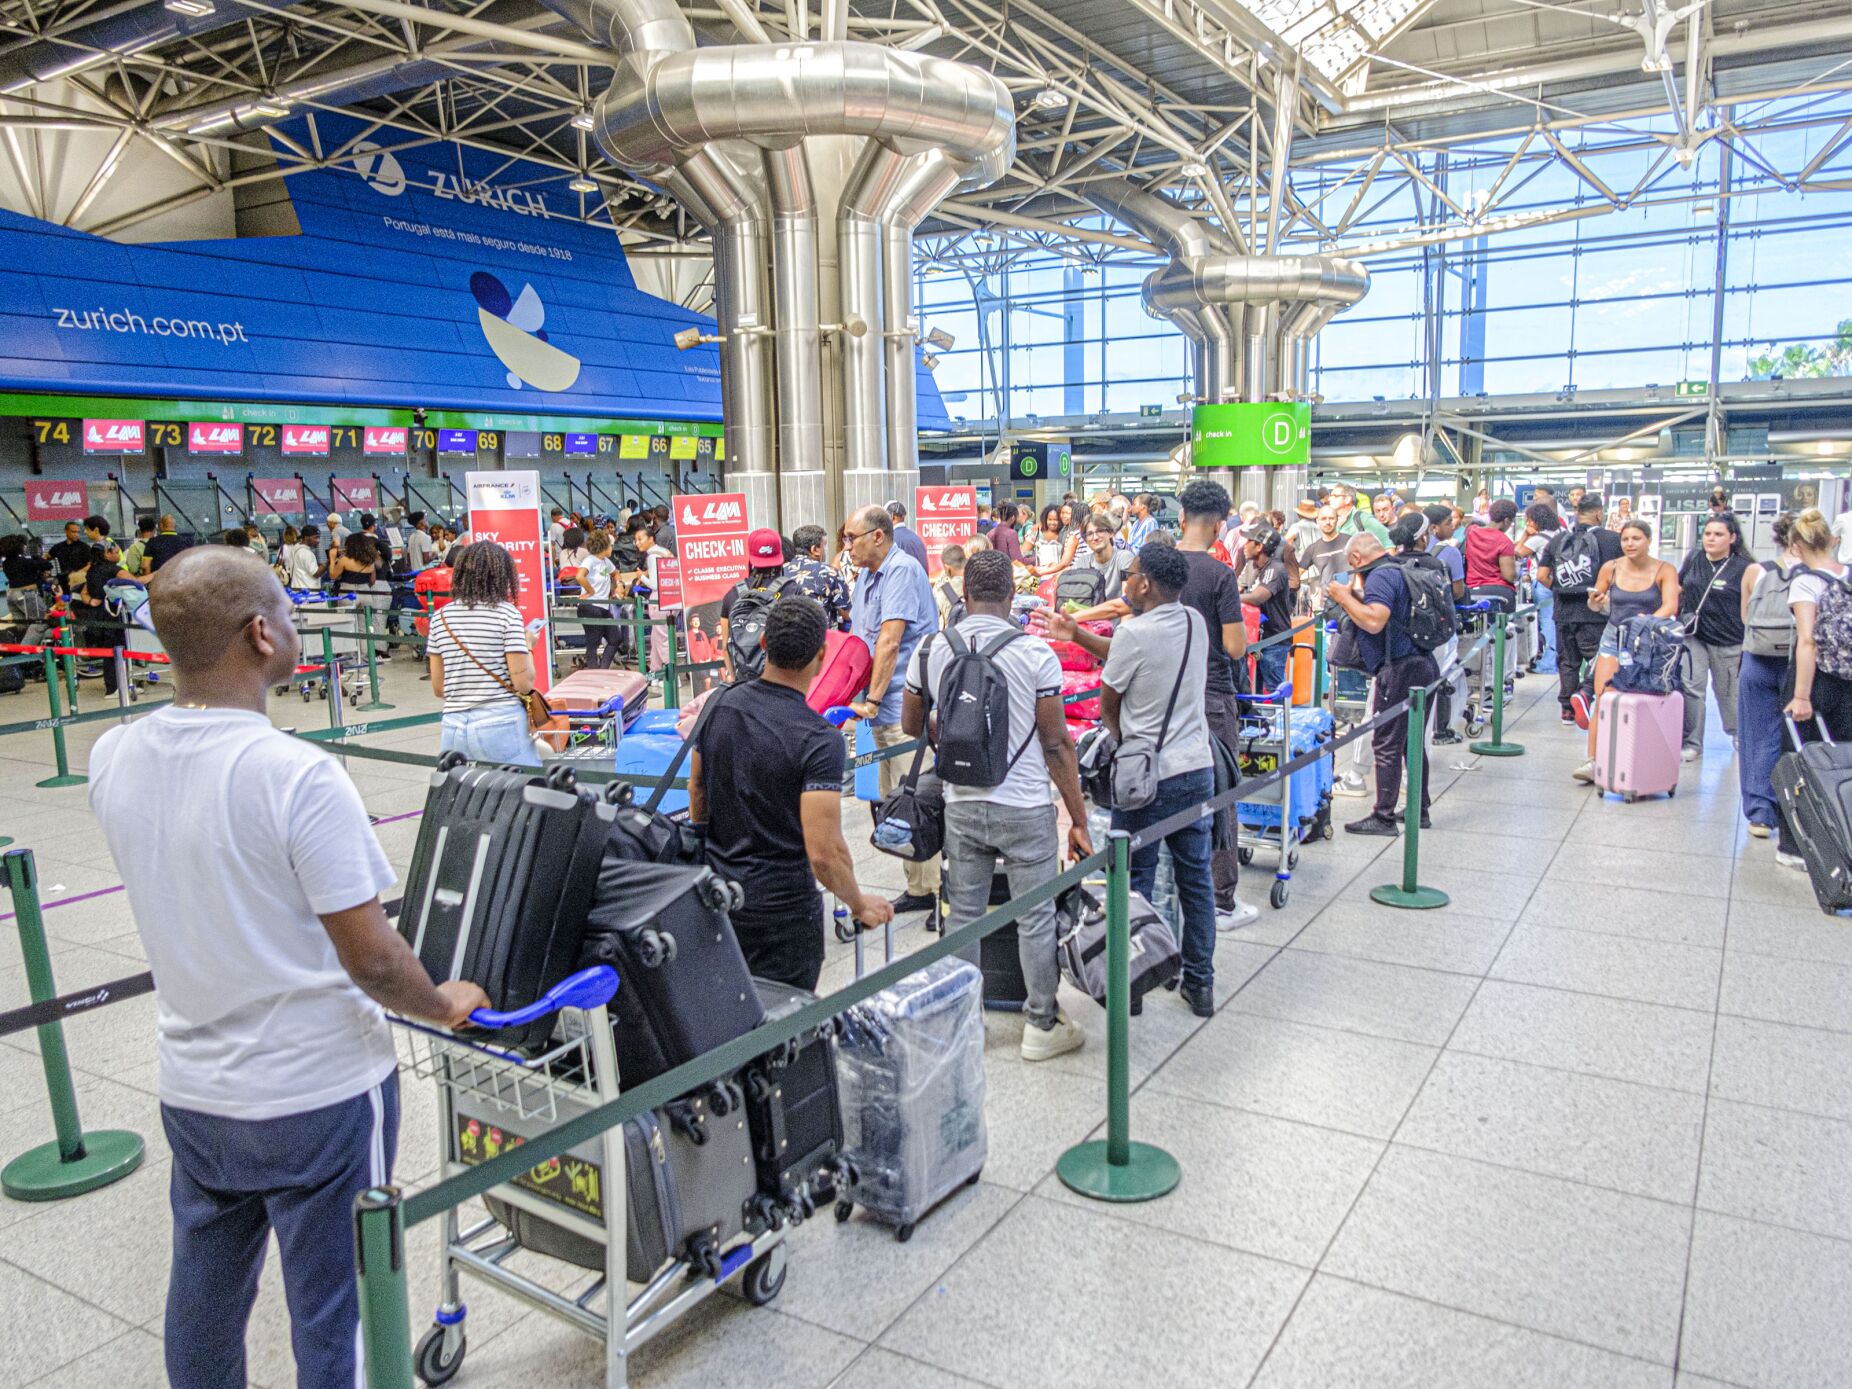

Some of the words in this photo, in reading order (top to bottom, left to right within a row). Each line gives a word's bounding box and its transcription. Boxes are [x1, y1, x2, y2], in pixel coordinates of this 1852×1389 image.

[427, 170, 550, 219] ZURICH
[383, 217, 431, 236] Portugal
[433, 227, 456, 240] está
[457, 232, 481, 244] mais
[482, 237, 516, 252] seguro
[518, 242, 547, 256] desde
[548, 247, 573, 261] 1918
[52, 307, 249, 346] zurich.com.pt
[35, 421, 70, 444] 74
[151, 424, 182, 445] 73
[249, 426, 275, 446] 72
[332, 429, 357, 448] 71
[414, 431, 435, 449] 70
[478, 432, 498, 450] 69
[1274, 421, 1290, 446] D
[544, 435, 562, 451] 68
[599, 437, 614, 452] 67
[652, 438, 668, 453] 66
[698, 440, 712, 454] 65
[1025, 460, 1034, 471] D
[1062, 457, 1068, 472] D
[938, 493, 971, 508] LAM
[1665, 499, 1708, 512] LISB
[702, 501, 741, 520] LAM
[475, 532, 499, 542] SKY
[922, 522, 971, 538] CHECK-IN
[685, 539, 745, 559] CHECK-IN
[694, 566, 715, 574] CLASSE
[716, 565, 747, 573] EXECUTIVA
[694, 573, 721, 581] BUSINESS
